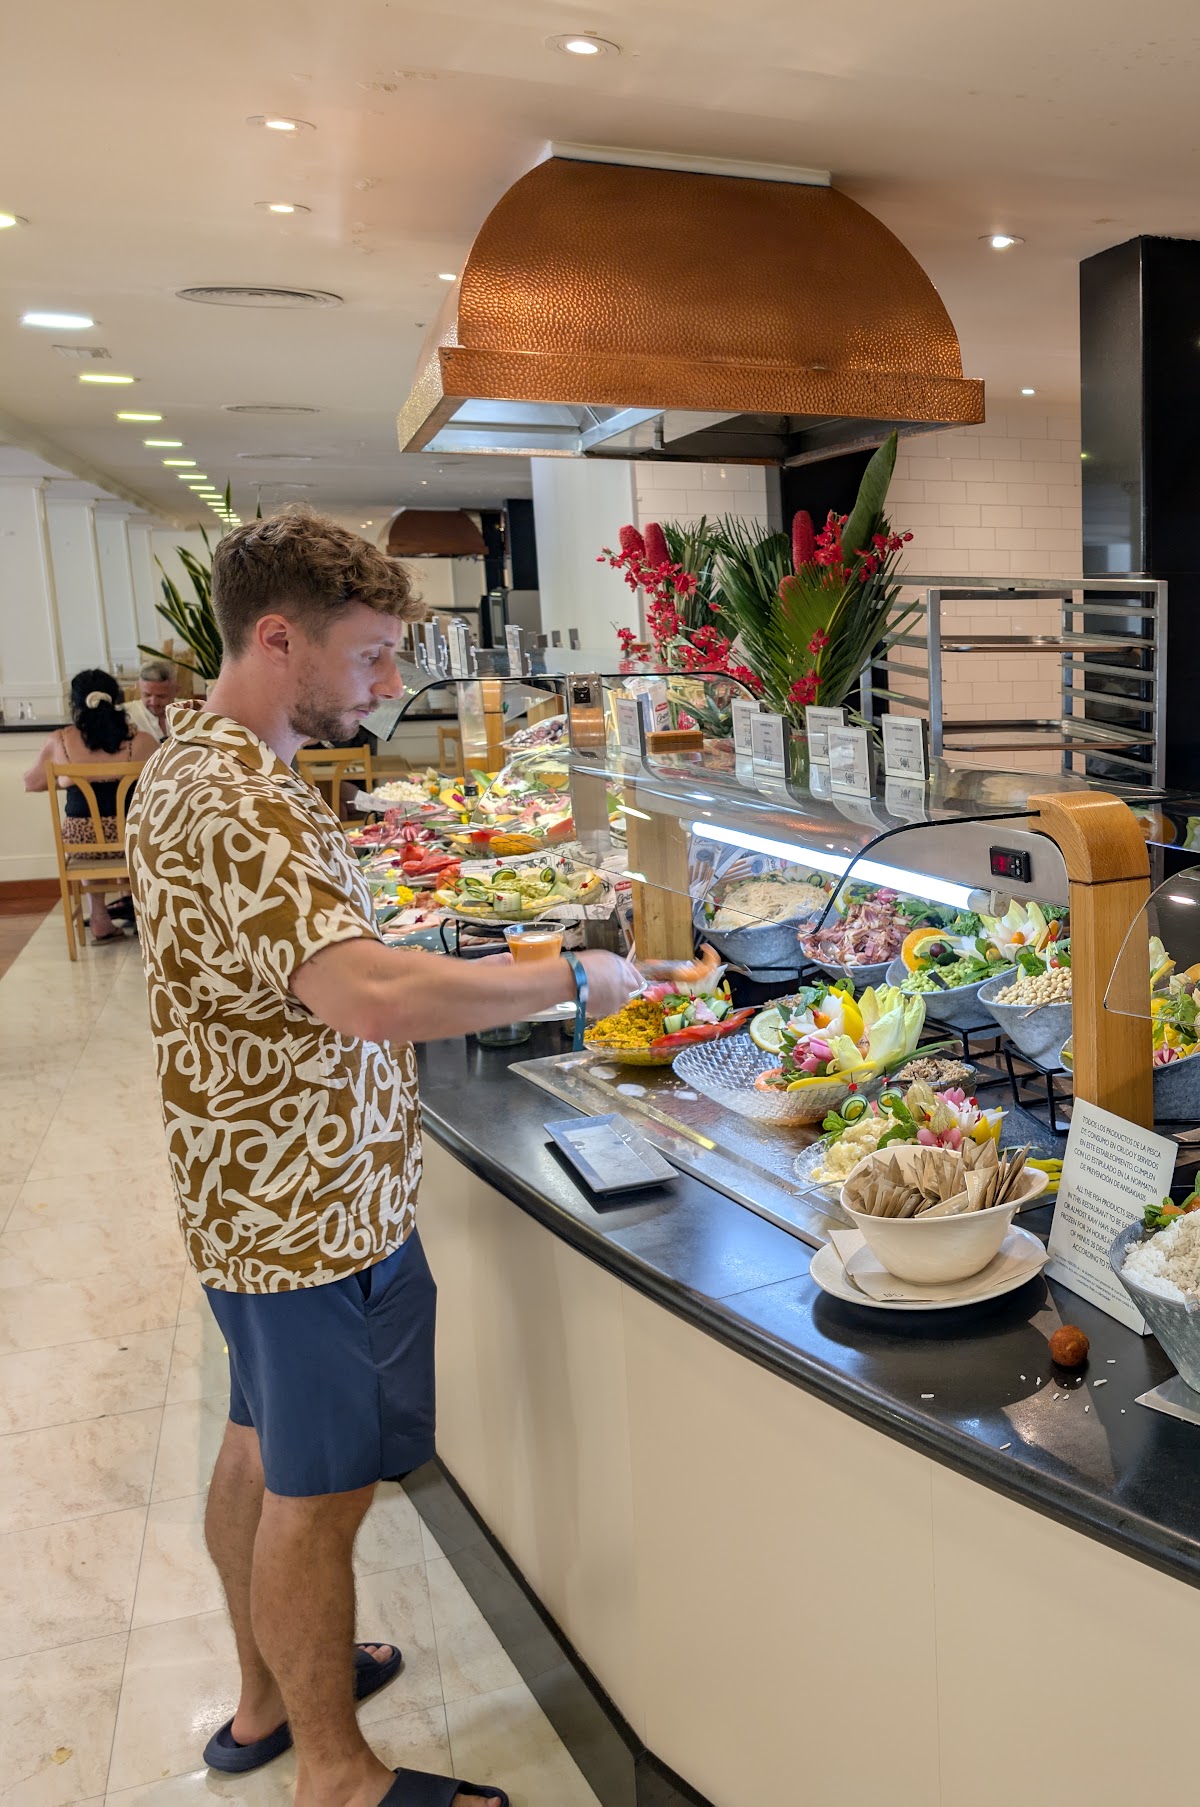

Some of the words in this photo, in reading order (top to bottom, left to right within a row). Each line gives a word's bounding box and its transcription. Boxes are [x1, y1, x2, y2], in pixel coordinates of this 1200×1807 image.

[1081, 1127, 1087, 1136] DE
[1087, 1130, 1110, 1146] CONSUMO
[1109, 1142, 1116, 1150] EN
[1116, 1144, 1133, 1157] CRUDO
[1137, 1154, 1159, 1170] SERVIDOS
[1082, 1116, 1097, 1128] TODOS
[1097, 1124, 1106, 1132] LOS
[1106, 1127, 1133, 1146] PRODUCTOS
[1133, 1140, 1140, 1149] DE
[1140, 1143, 1146, 1152] LA
[1146, 1146, 1162, 1159] PESCA
[1074, 1147, 1085, 1158] CON
[1084, 1152, 1091, 1161] LO
[1091, 1156, 1117, 1175] ESTIPULADO
[1116, 1169, 1124, 1178] EN
[1130, 1176, 1158, 1195] NORMATIVA
[1080, 1138, 1086, 1146] EN
[1086, 1141, 1096, 1151] ESTE
[1134, 1165, 1156, 1181] CUMPLEN
[1080, 1162, 1086, 1171] DE
[1086, 1166, 1113, 1185] PREVENCIÓN
[1113, 1180, 1120, 1189] DE
[1064, 1201, 1070, 1209] OR
[1070, 1204, 1087, 1218] ALMOST
[1087, 1214, 1098, 1224] RAW
[1098, 1220, 1109, 1233] HAVE
[1067, 1191, 1073, 1199] IN
[1072, 1194, 1082, 1205] THIS
[1081, 1199, 1109, 1219] RESTAURANT
[1109, 1214, 1115, 1222] TO
[1115, 1218, 1121, 1226] BE
[1076, 1185, 1084, 1194] ALL
[1084, 1188, 1092, 1198] THE
[1092, 1193, 1101, 1203] FISH
[1101, 1198, 1126, 1216] PRODUCTS
[1060, 1211, 1077, 1225] FROZEN
[1077, 1221, 1086, 1230] FOR
[1092, 1230, 1107, 1244] HOURS
[1070, 1229, 1076, 1237] OF
[1076, 1233, 1090, 1246] MINUS
[1090, 1241, 1096, 1249] 20
[1071, 1243, 1100, 1263] ACCORDING
[1099, 1258, 1106, 1267] TO
